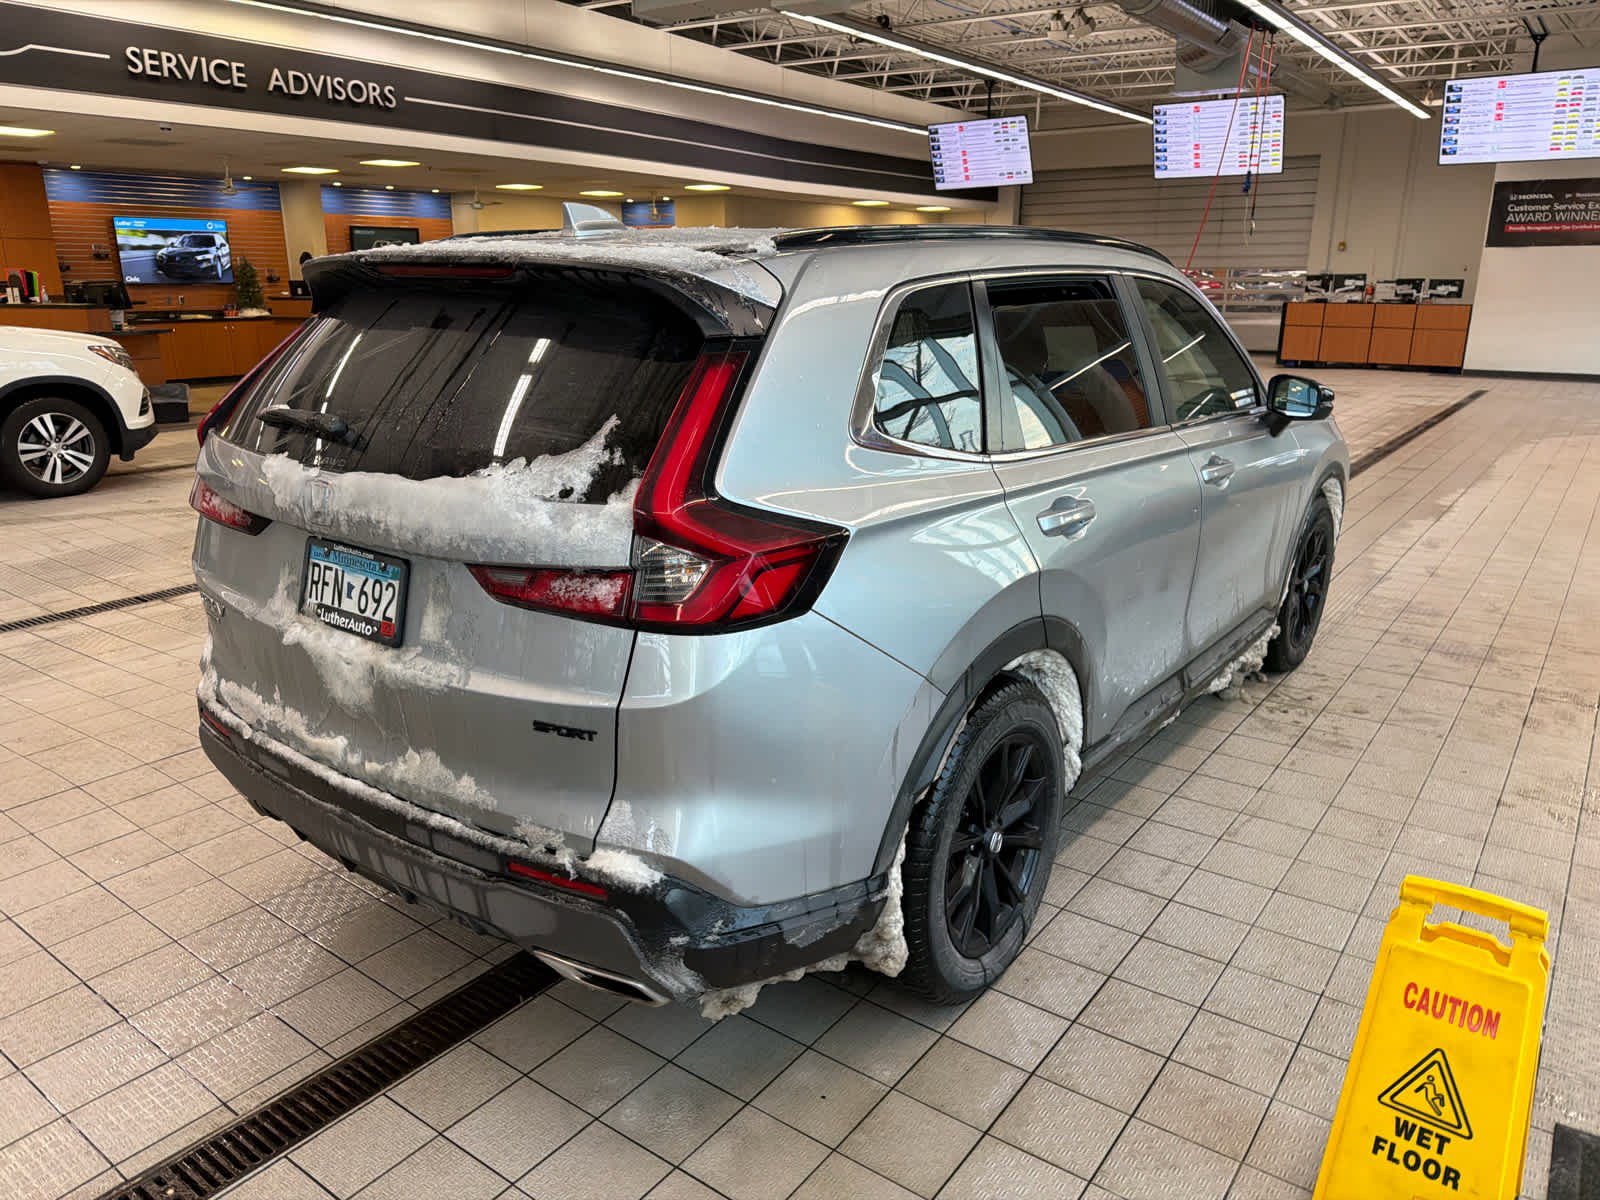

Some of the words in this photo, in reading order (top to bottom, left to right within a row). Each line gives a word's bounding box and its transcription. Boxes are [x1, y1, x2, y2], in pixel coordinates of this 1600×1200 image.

[125, 46, 248, 88] SERVICE
[267, 67, 397, 109] ADVISORS
[1506, 212, 1552, 222] AWARD
[1554, 210, 1600, 222] WINNE
[1507, 203, 1550, 212] Customer
[1553, 202, 1586, 211] Service
[332, 551, 378, 573] Minnesota
[308, 561, 345, 608] RFN
[357, 576, 396, 623] 692
[319, 606, 373, 636] LutherAuto
[532, 719, 598, 742] SPORT
[1403, 981, 1501, 1041] CAUTION
[1393, 1115, 1451, 1156] WET
[1371, 1135, 1462, 1191] FLOOR
